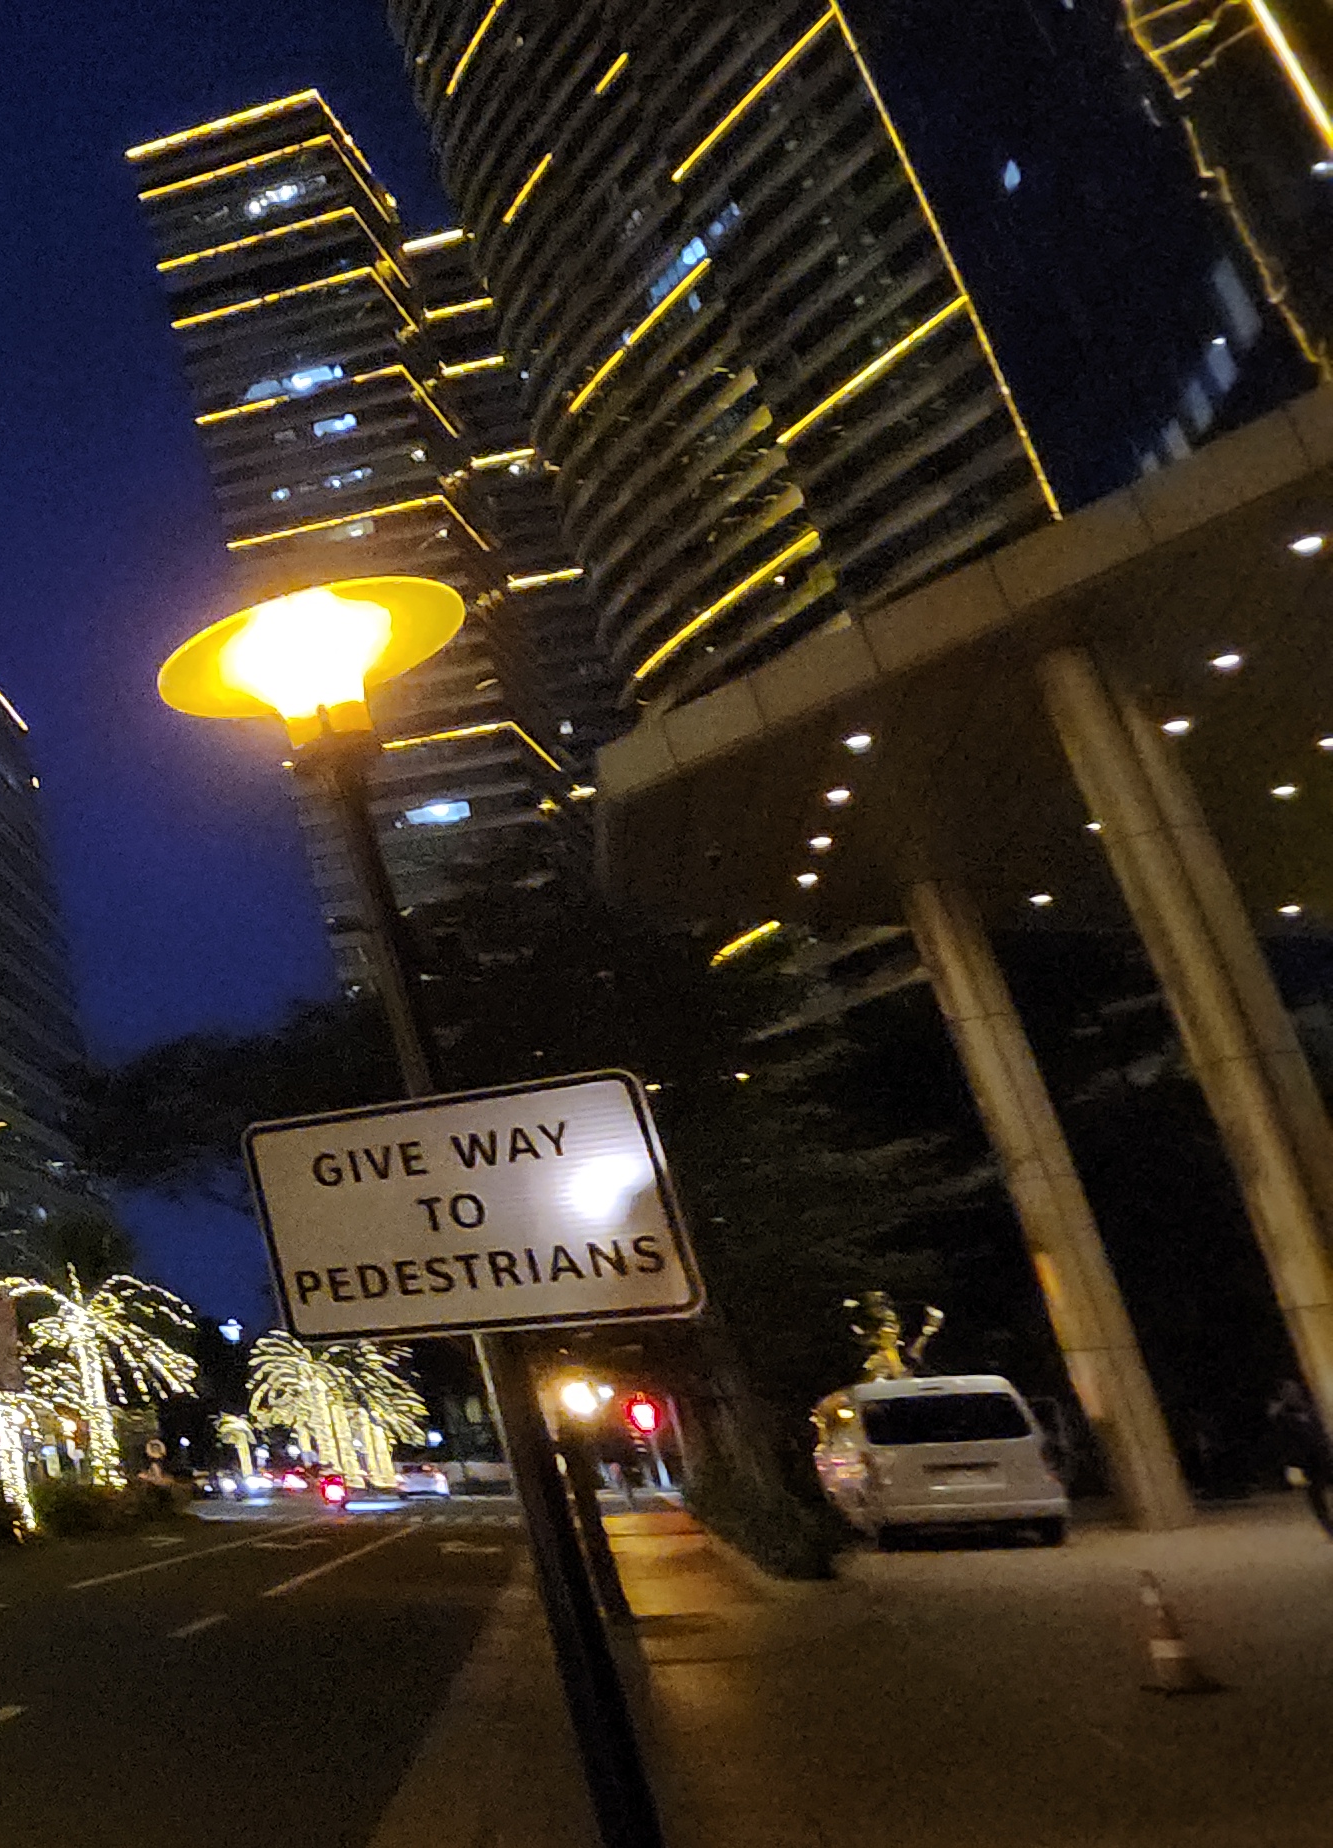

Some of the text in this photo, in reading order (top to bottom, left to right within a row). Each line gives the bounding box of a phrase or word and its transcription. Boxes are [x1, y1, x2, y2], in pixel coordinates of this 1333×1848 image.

[312, 1120, 566, 1188] GIVE WAY
[417, 1193, 485, 1232] TO
[294, 1234, 666, 1305] PEDESTRIANS
